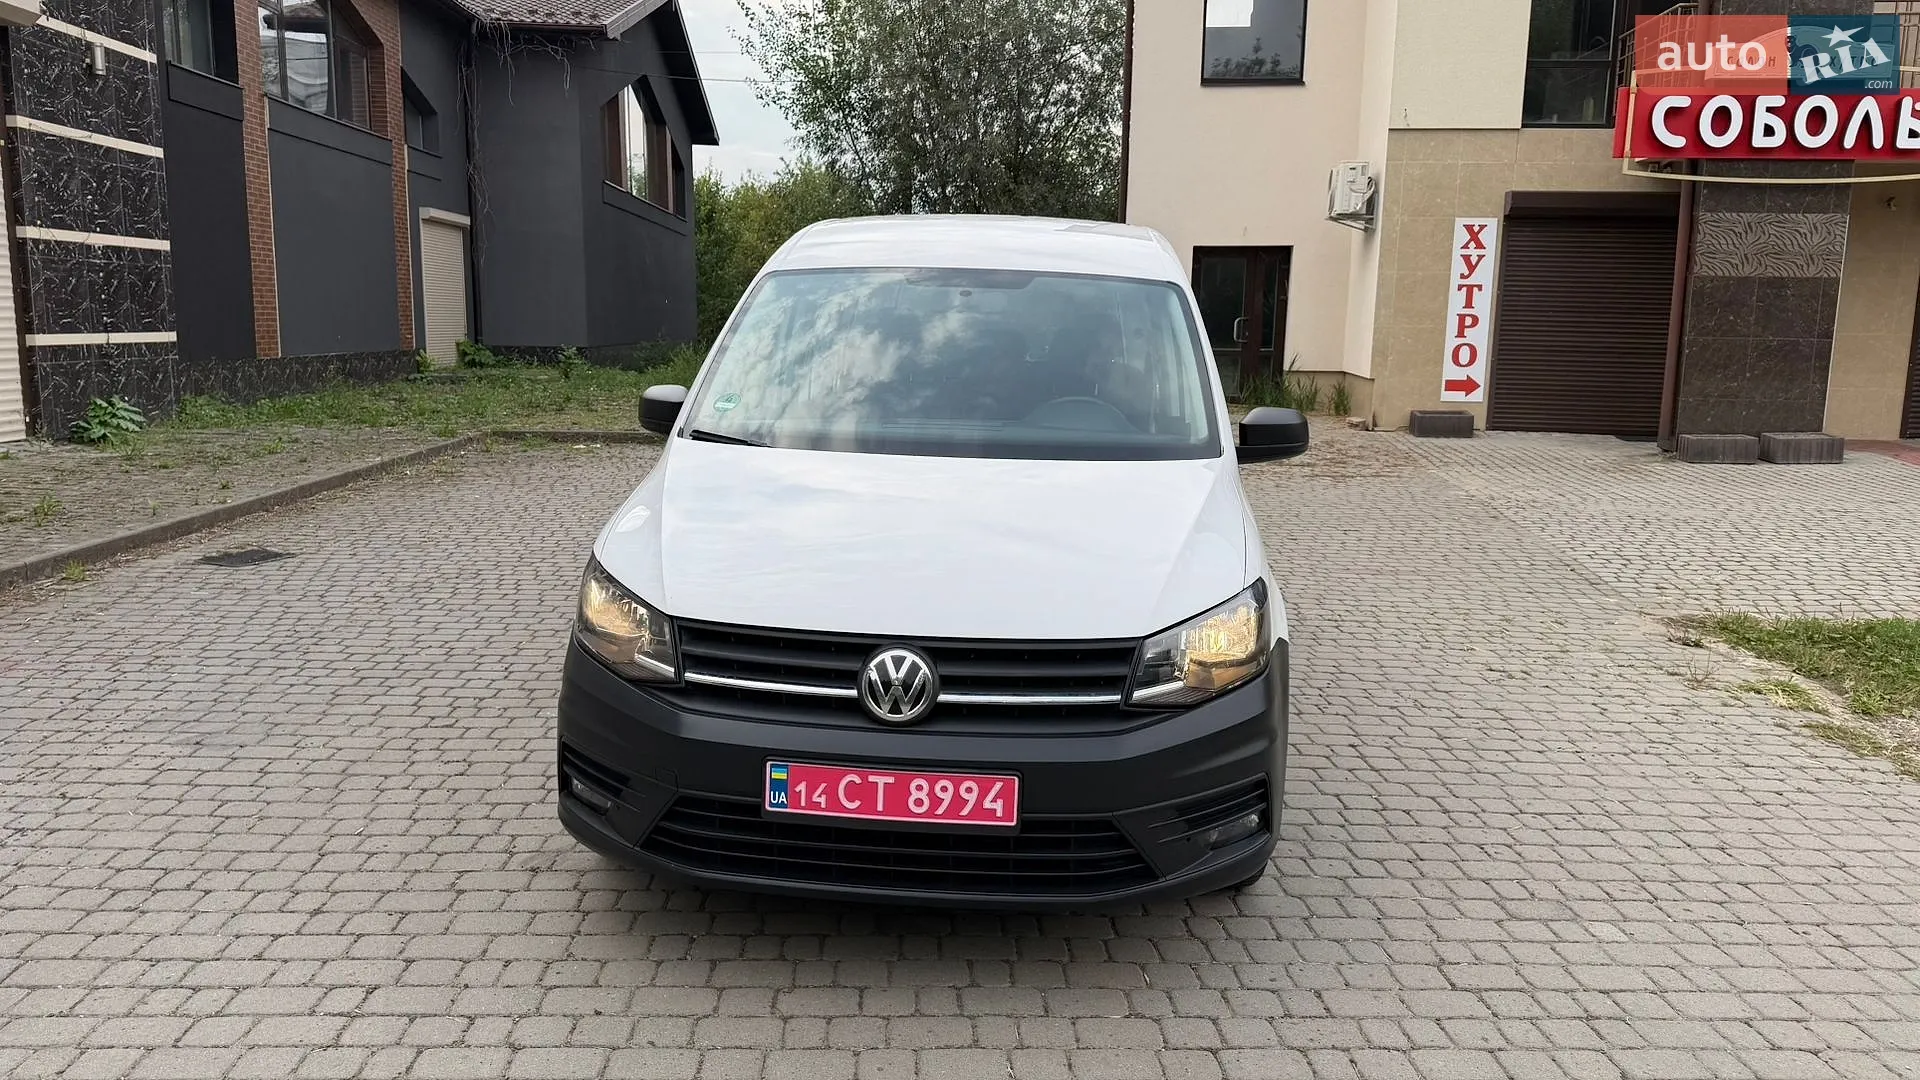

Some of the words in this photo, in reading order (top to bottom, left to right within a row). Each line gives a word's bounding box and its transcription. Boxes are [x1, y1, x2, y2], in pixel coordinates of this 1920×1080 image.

[1652, 95, 1920, 149] СОБОЛЬ
[1451, 224, 1488, 368] ХУТРО
[864, 650, 931, 719] VW
[770, 790, 788, 804] UA
[794, 780, 828, 809] 14
[837, 773, 895, 812] CT
[907, 777, 1005, 818] 8994
